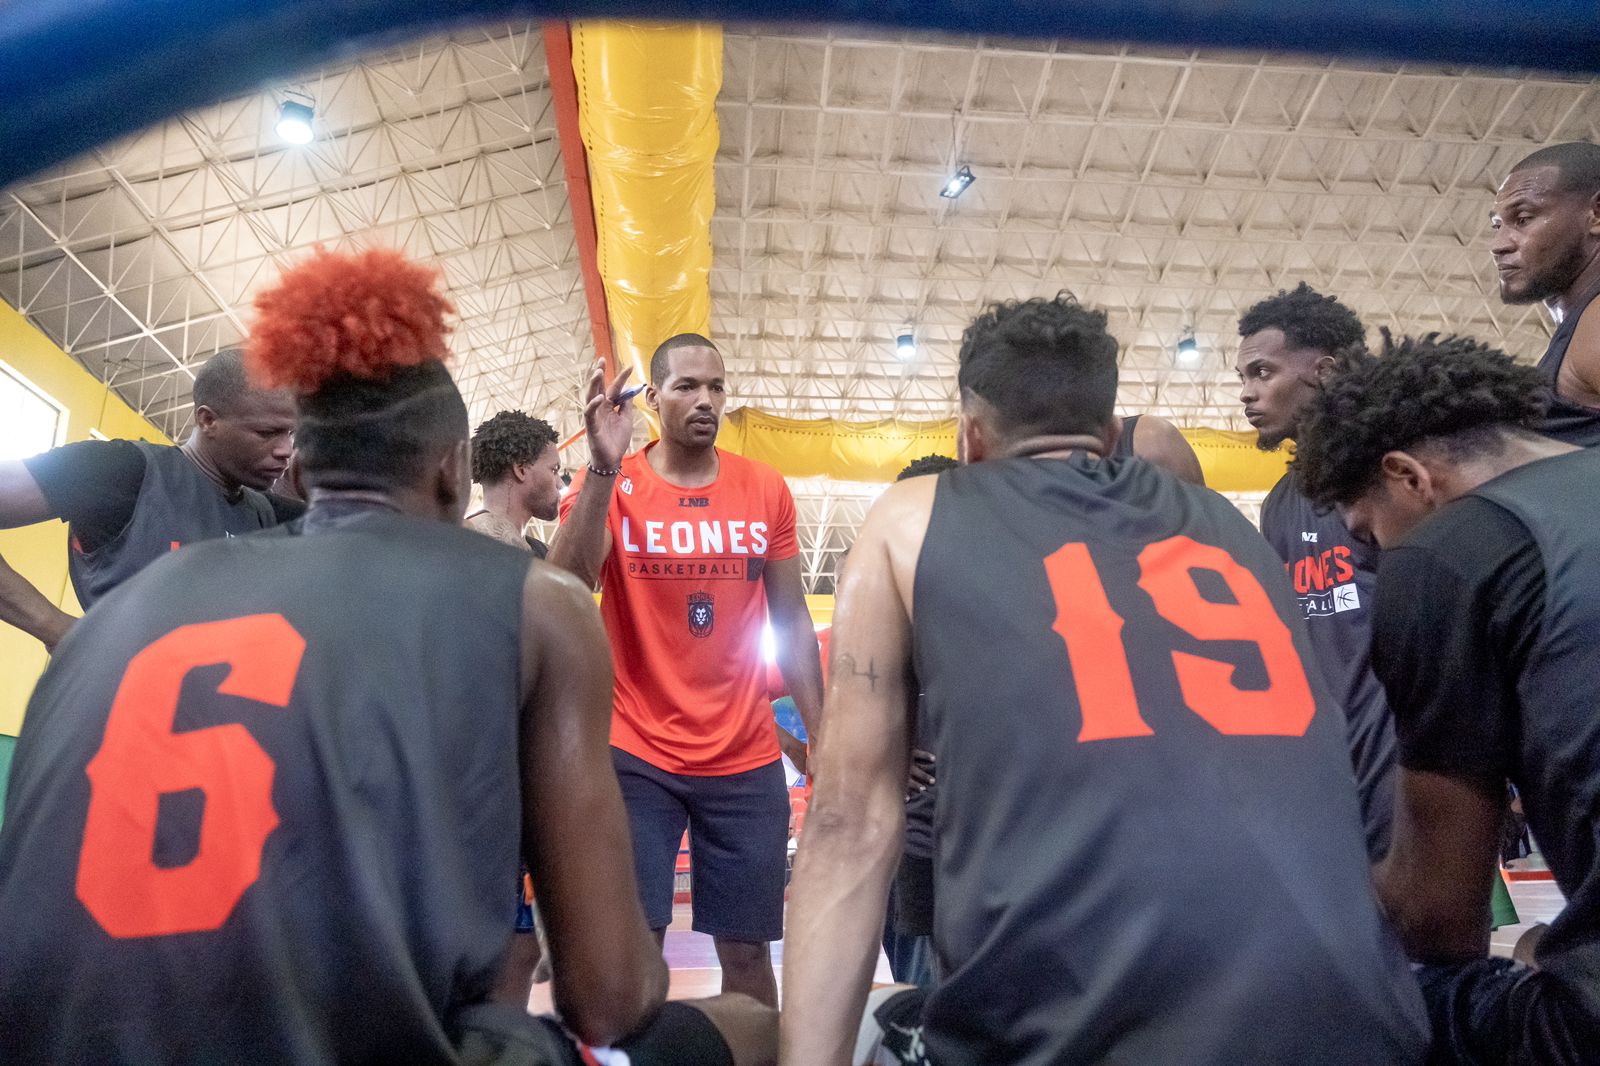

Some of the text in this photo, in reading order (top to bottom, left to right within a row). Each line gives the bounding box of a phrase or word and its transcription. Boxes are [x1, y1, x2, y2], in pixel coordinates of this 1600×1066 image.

[679, 497, 710, 507] LNB
[622, 516, 768, 554] LEONES
[629, 562, 740, 575] BASKETBALL
[1290, 546, 1354, 593] ONES
[1043, 535, 1316, 742] 19
[76, 613, 306, 938] 6
